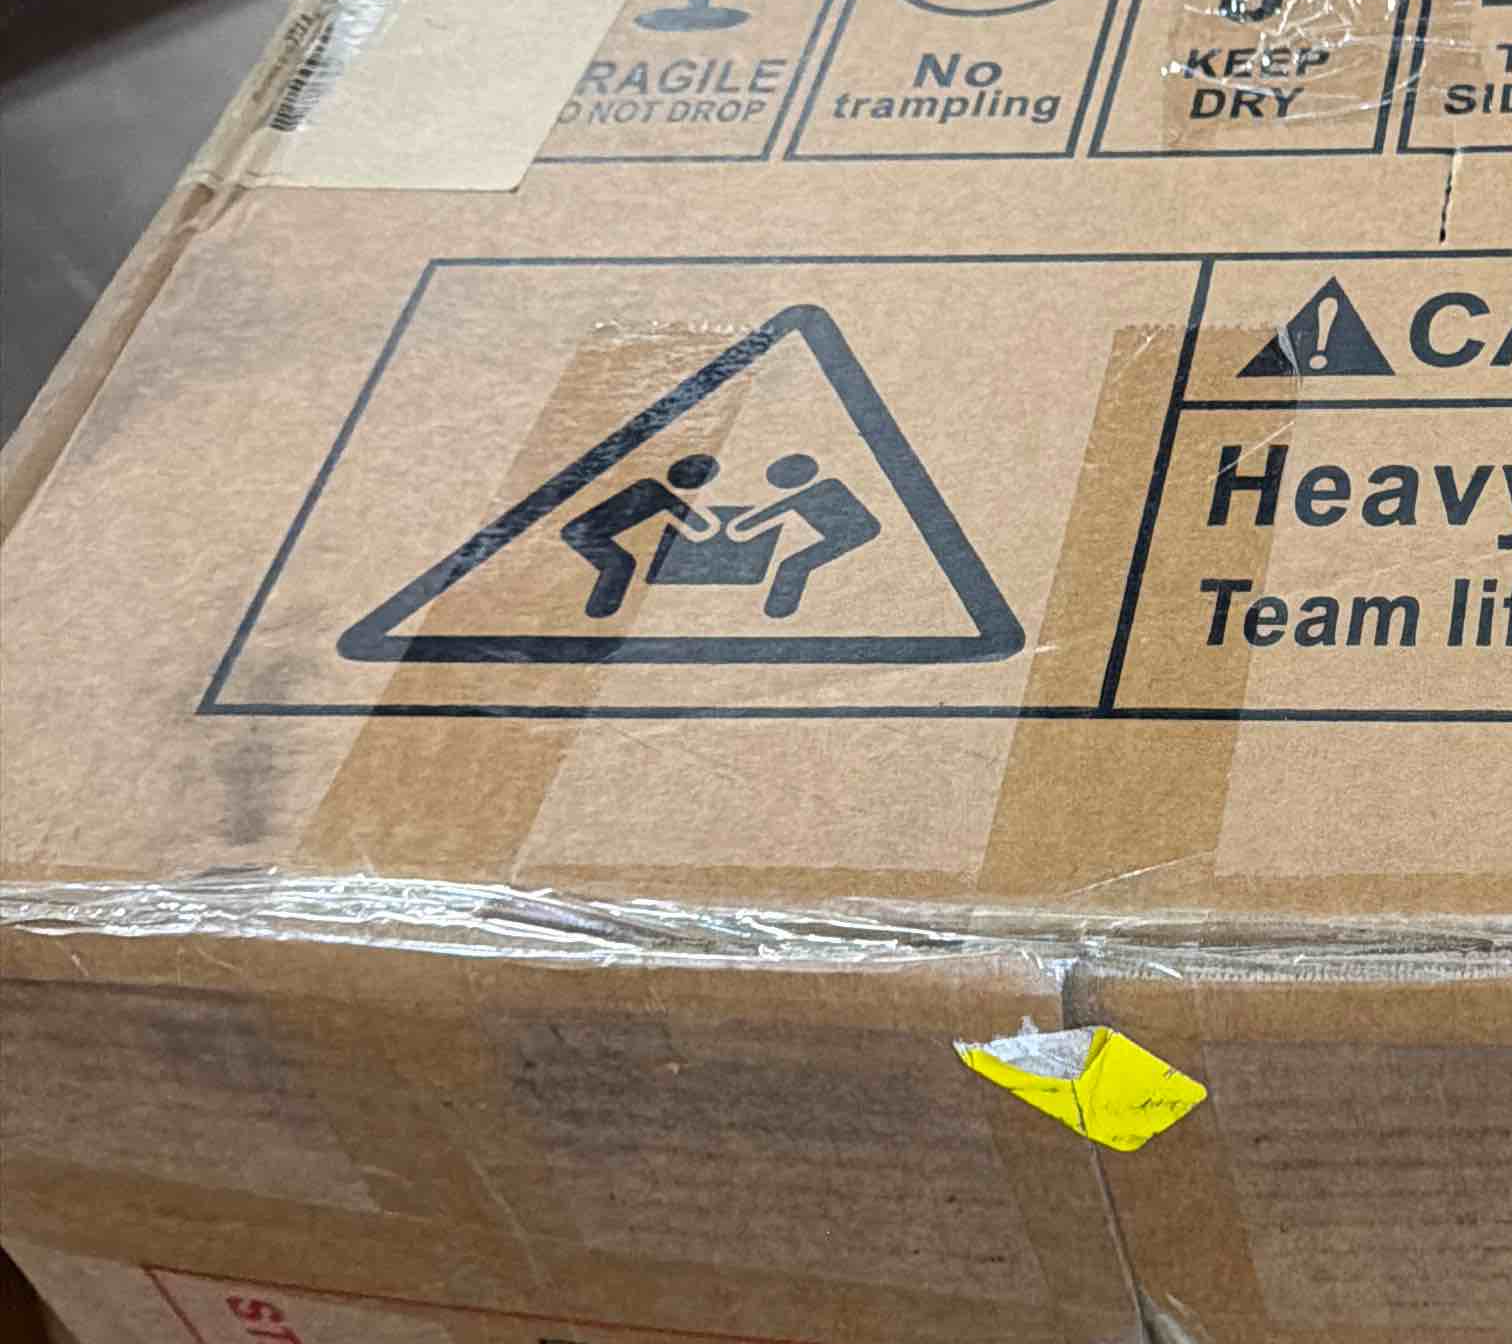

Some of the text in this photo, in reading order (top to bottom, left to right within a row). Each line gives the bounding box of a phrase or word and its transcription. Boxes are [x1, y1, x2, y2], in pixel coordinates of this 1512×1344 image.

[576, 58, 787, 96] RAGILE
[911, 52, 1003, 89] No
[1180, 46, 1330, 80] KEEP
[557, 99, 768, 124] O NOT DROP
[832, 90, 1062, 124] trampling
[1188, 86, 1304, 120] DRY
[1200, 578, 1420, 648] Team
